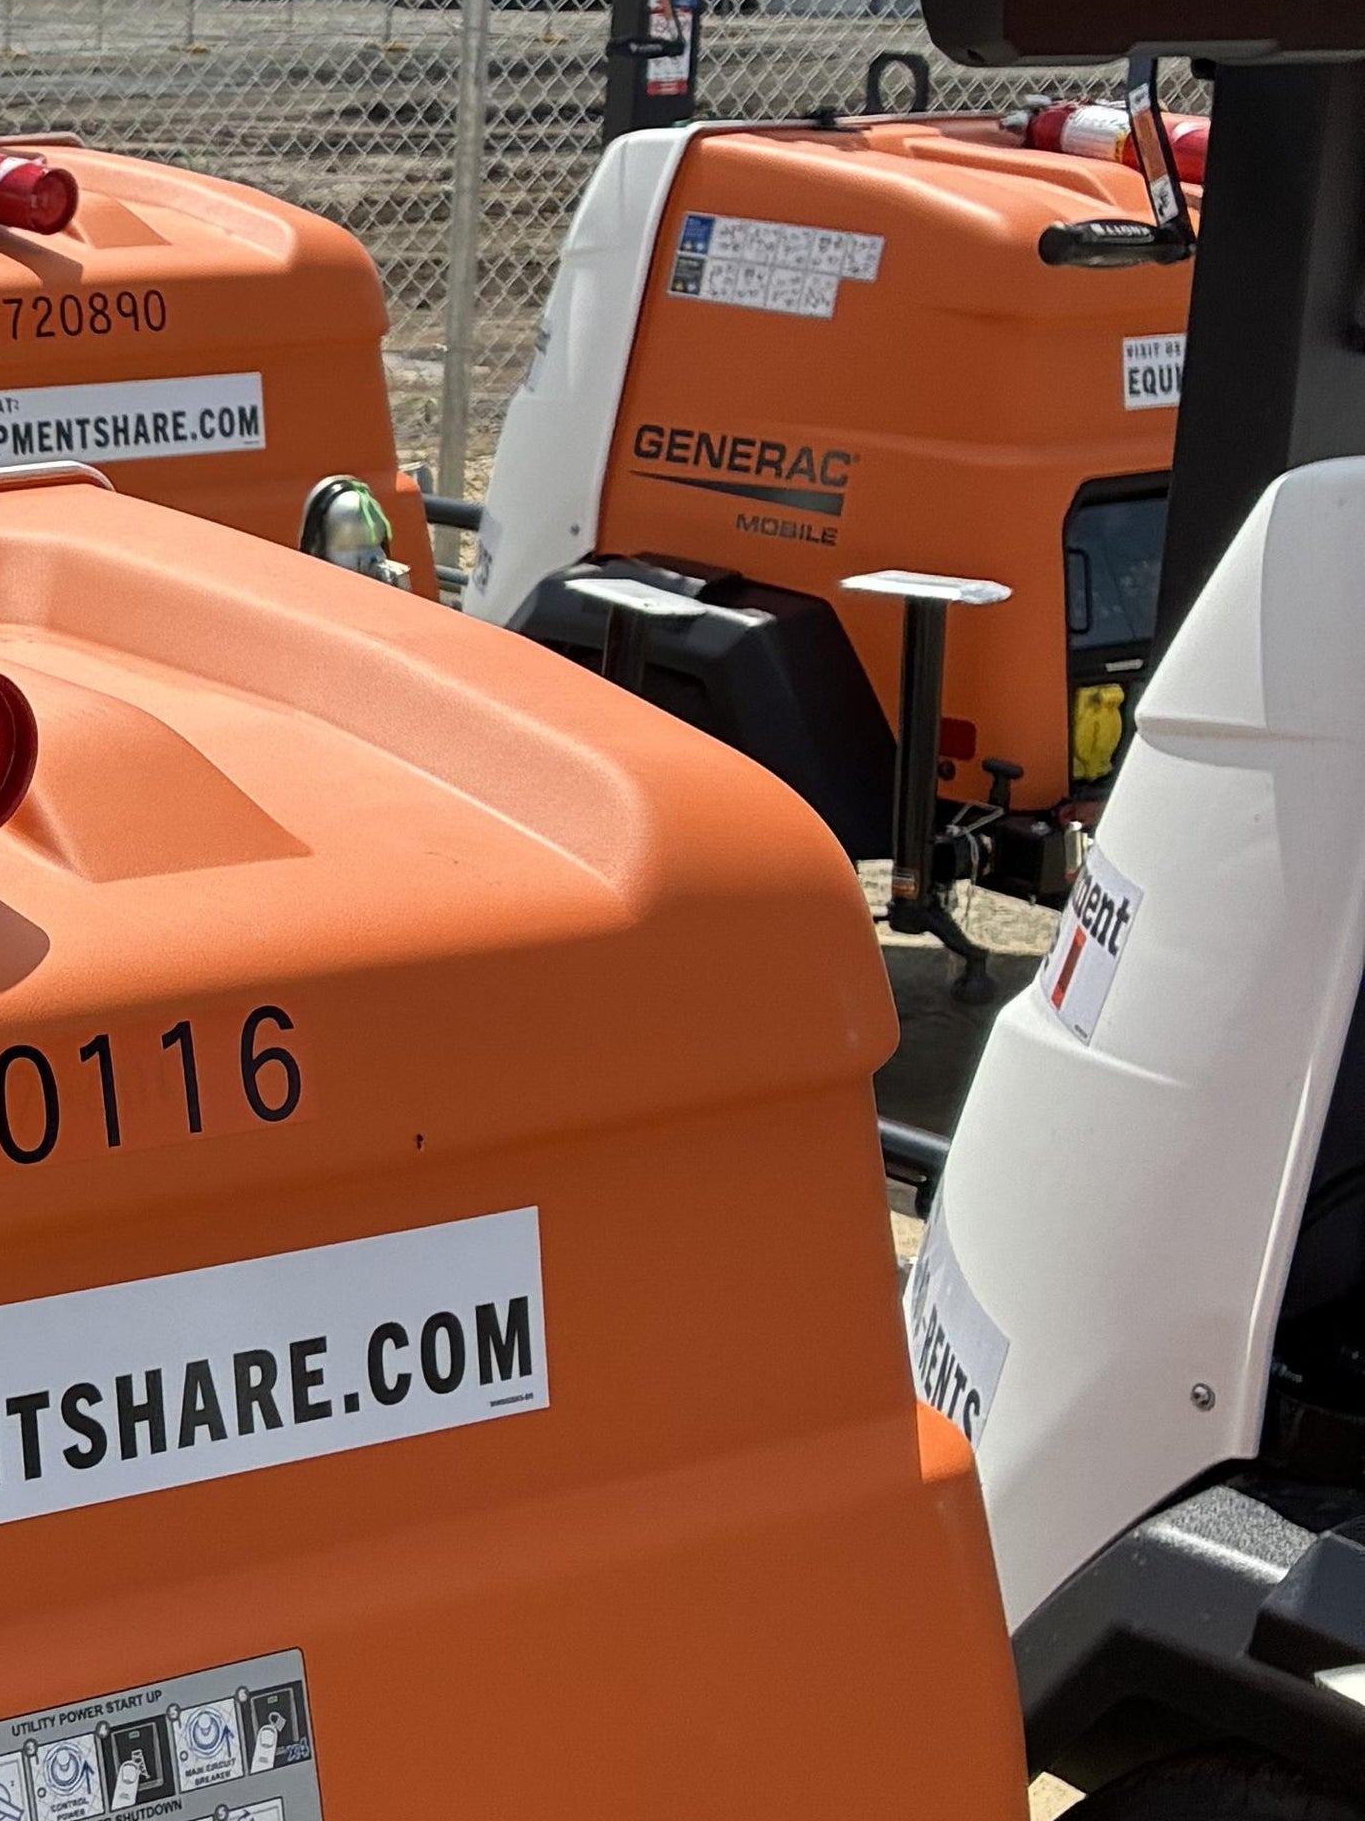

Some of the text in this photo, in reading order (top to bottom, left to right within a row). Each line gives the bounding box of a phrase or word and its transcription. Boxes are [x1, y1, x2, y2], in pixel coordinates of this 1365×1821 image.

[2, 289, 166, 339] 720890
[634, 424, 851, 487] GENERAC
[736, 514, 838, 546] MOBILE
[11, 1690, 162, 1736] UTILITY POWER START UP
